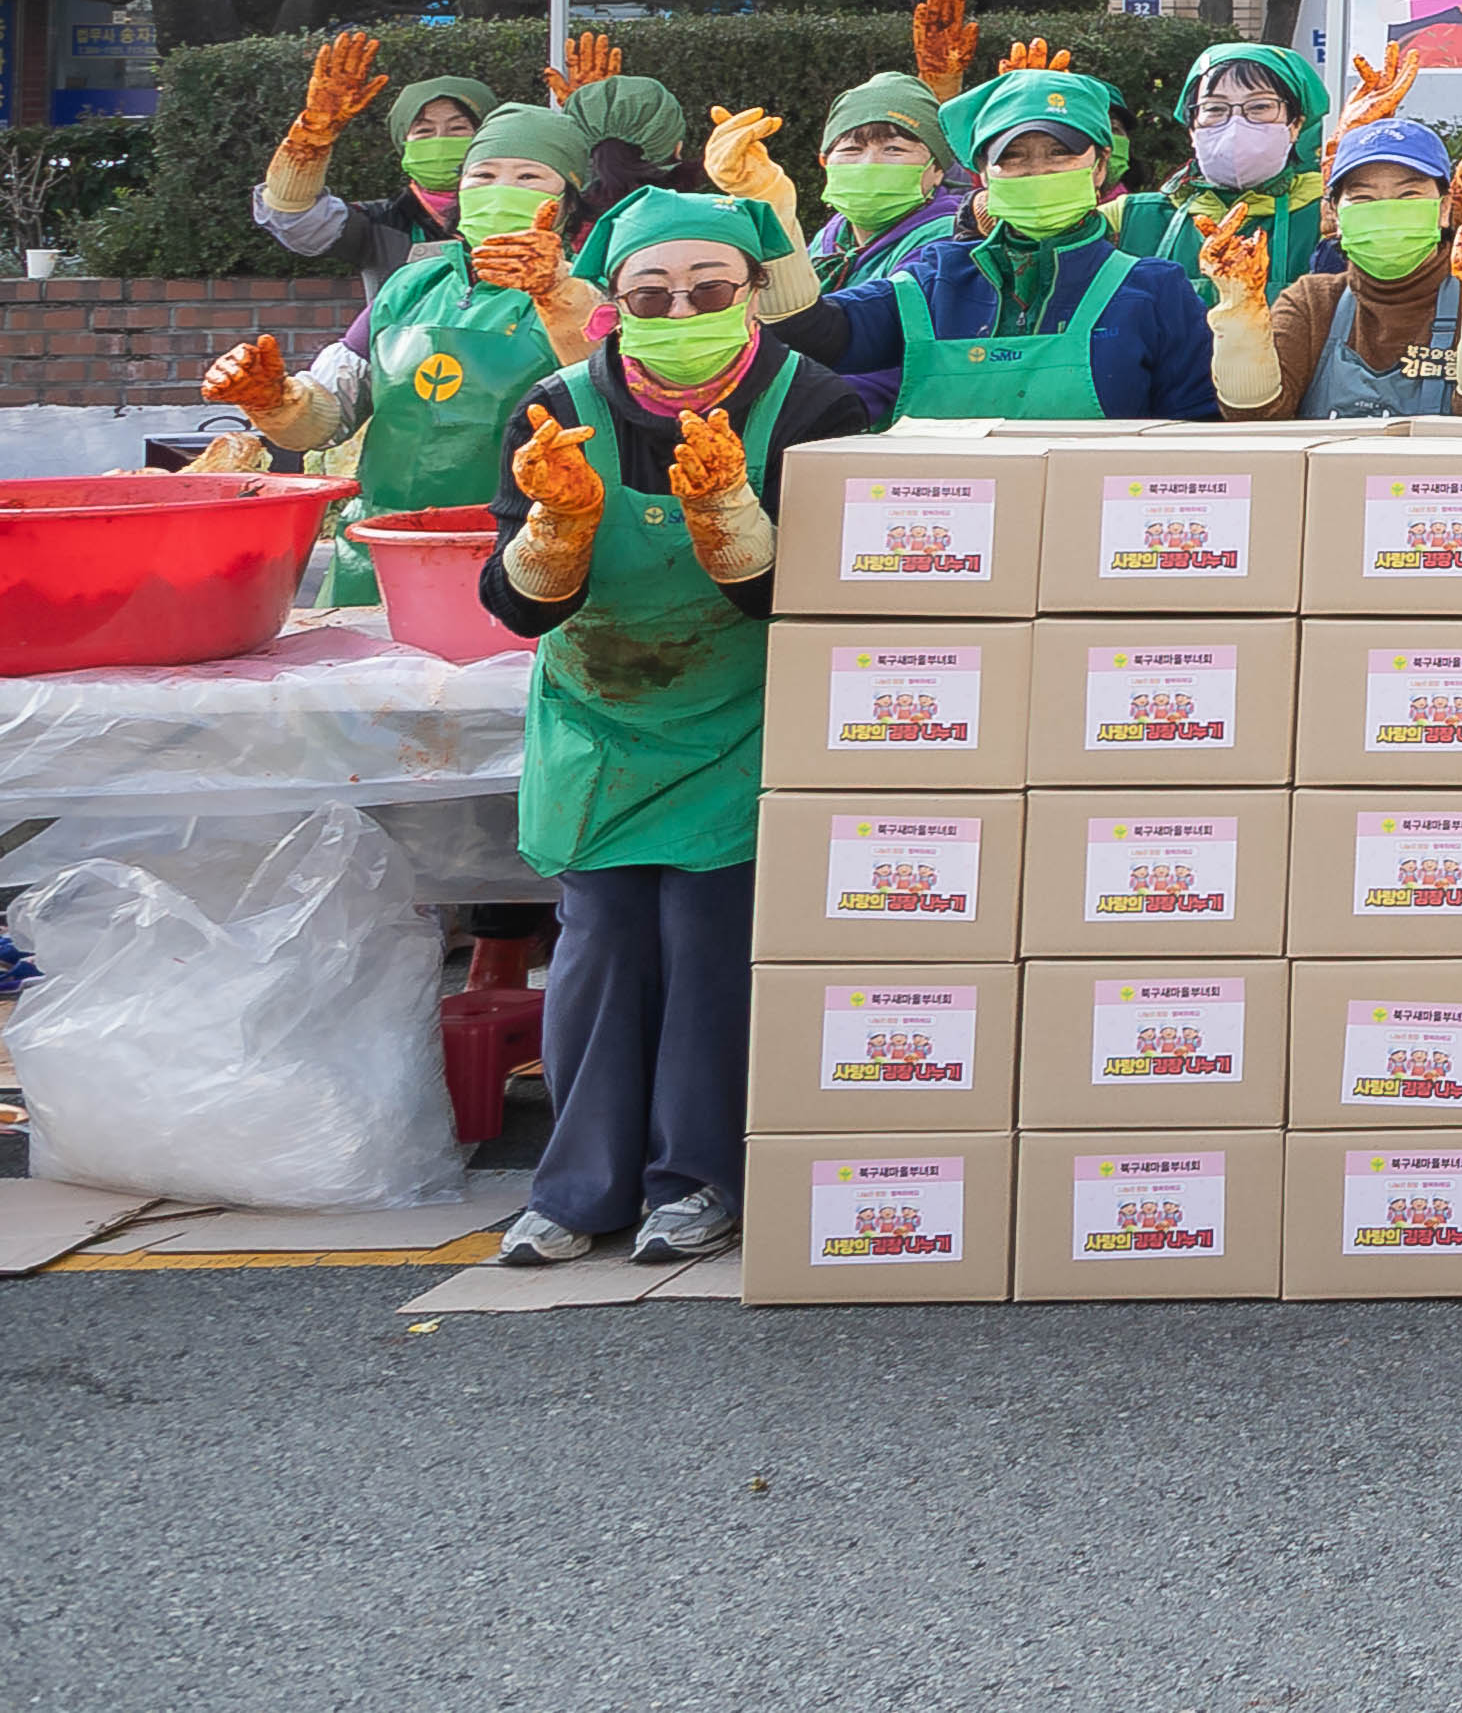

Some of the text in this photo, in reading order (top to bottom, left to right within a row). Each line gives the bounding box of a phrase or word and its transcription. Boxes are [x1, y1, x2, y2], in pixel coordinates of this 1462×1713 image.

[1134, 2, 1151, 15] 32
[891, 486, 971, 496] 북구새마을부녀회
[1148, 483, 1227, 493] 북구새마을부녀회
[851, 553, 981, 572] 사랑의 김장 나누기
[1110, 550, 1237, 569] 사랑의 김장 나누기
[1133, 825, 1213, 836] 북구새마을부녀회
[1095, 893, 1224, 913] 사랑의 김장 나누기
[1353, 1227, 1402, 1246] 사랑의
[1401, 1226, 1435, 1245] 김장
